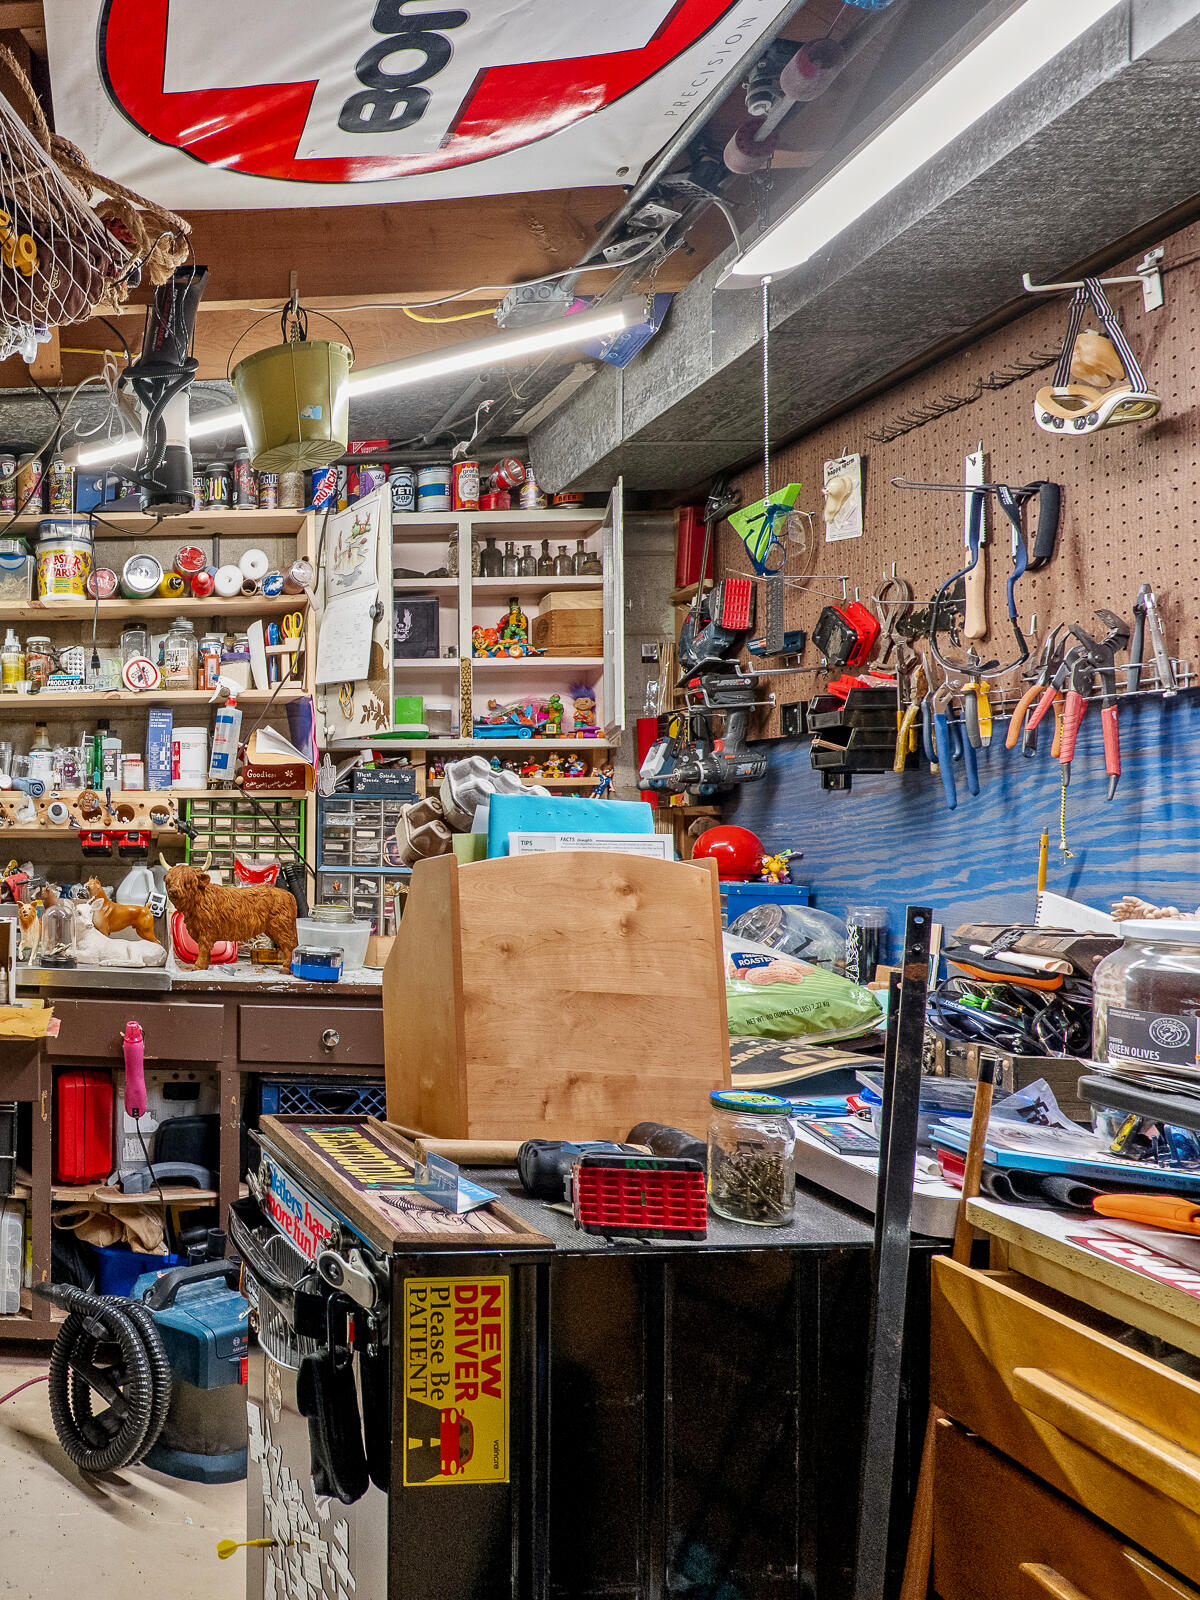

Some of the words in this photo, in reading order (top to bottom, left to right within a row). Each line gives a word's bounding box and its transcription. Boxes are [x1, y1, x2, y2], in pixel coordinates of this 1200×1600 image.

[664, 16, 758, 117] PRECISION
[313, 469, 337, 507] CRUNCH
[392, 487, 413, 496] YETI
[746, 1018, 756, 1026] NET
[1108, 1042, 1130, 1055] QUEEN
[1131, 1047, 1160, 1060] OLIVES
[305, 1131, 416, 1184] RESTROOM
[409, 1287, 428, 1398] PATIENT
[430, 1286, 451, 1364] Please
[454, 1285, 479, 1403] DRIVER
[480, 1285, 502, 1399] NEW
[430, 1370, 450, 1401] Be
